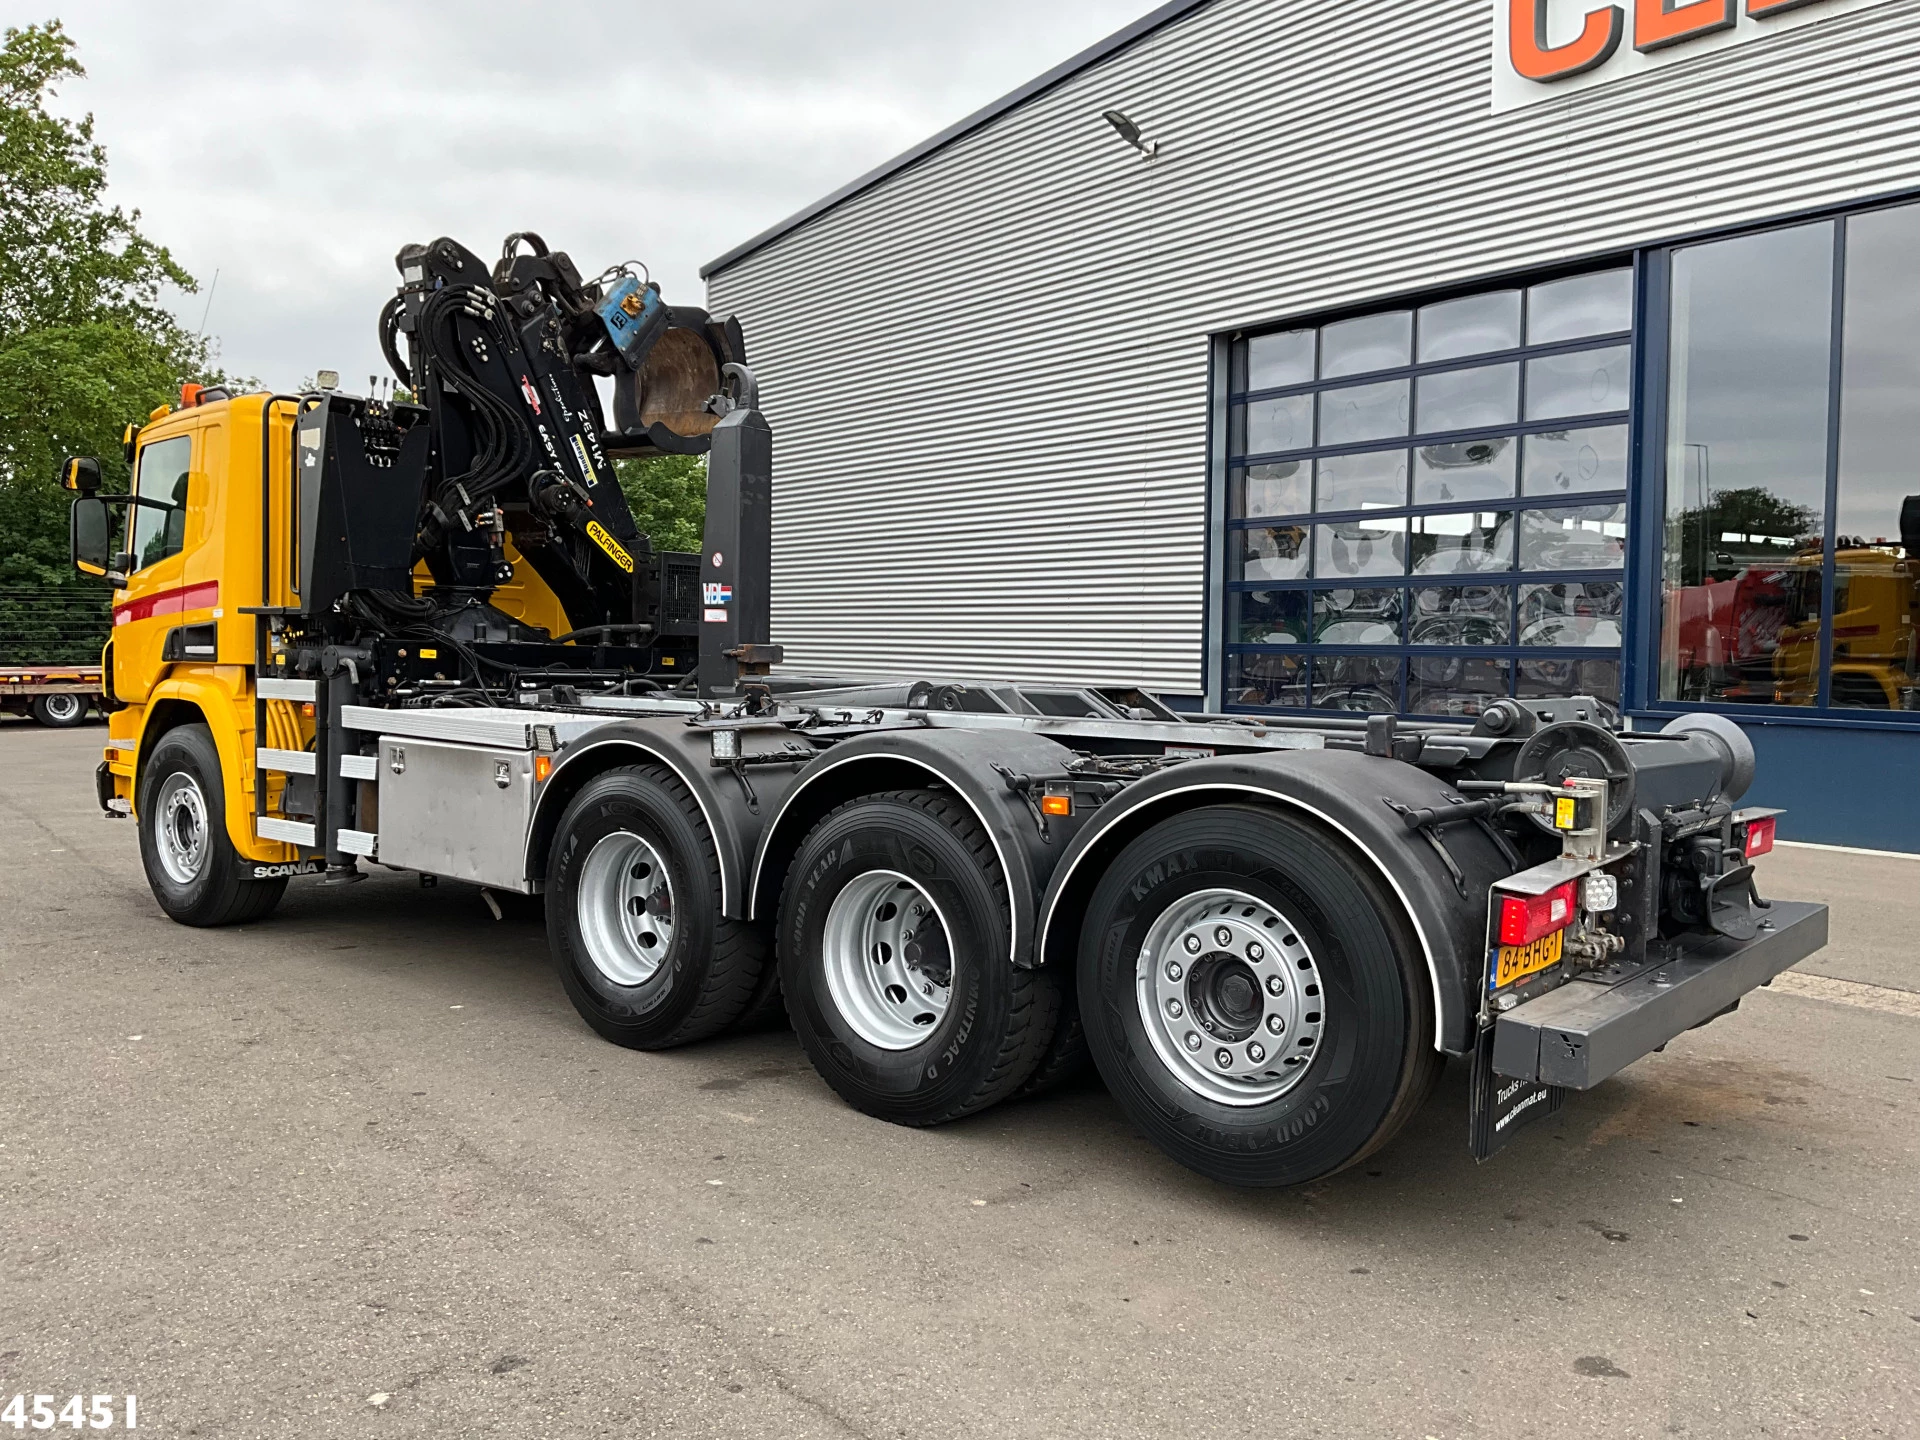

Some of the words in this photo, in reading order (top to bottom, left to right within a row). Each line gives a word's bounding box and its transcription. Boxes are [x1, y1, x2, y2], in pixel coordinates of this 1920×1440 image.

[538, 424, 557, 458] EASY
[589, 523, 632, 570] PALFINGER
[703, 583, 725, 605] VDL
[254, 862, 318, 879] SCANIA
[1130, 851, 1198, 902] KMAX
[1497, 1079, 1519, 1105] Trucks
[1495, 1089, 1547, 1132] www.cleanmat.eu
